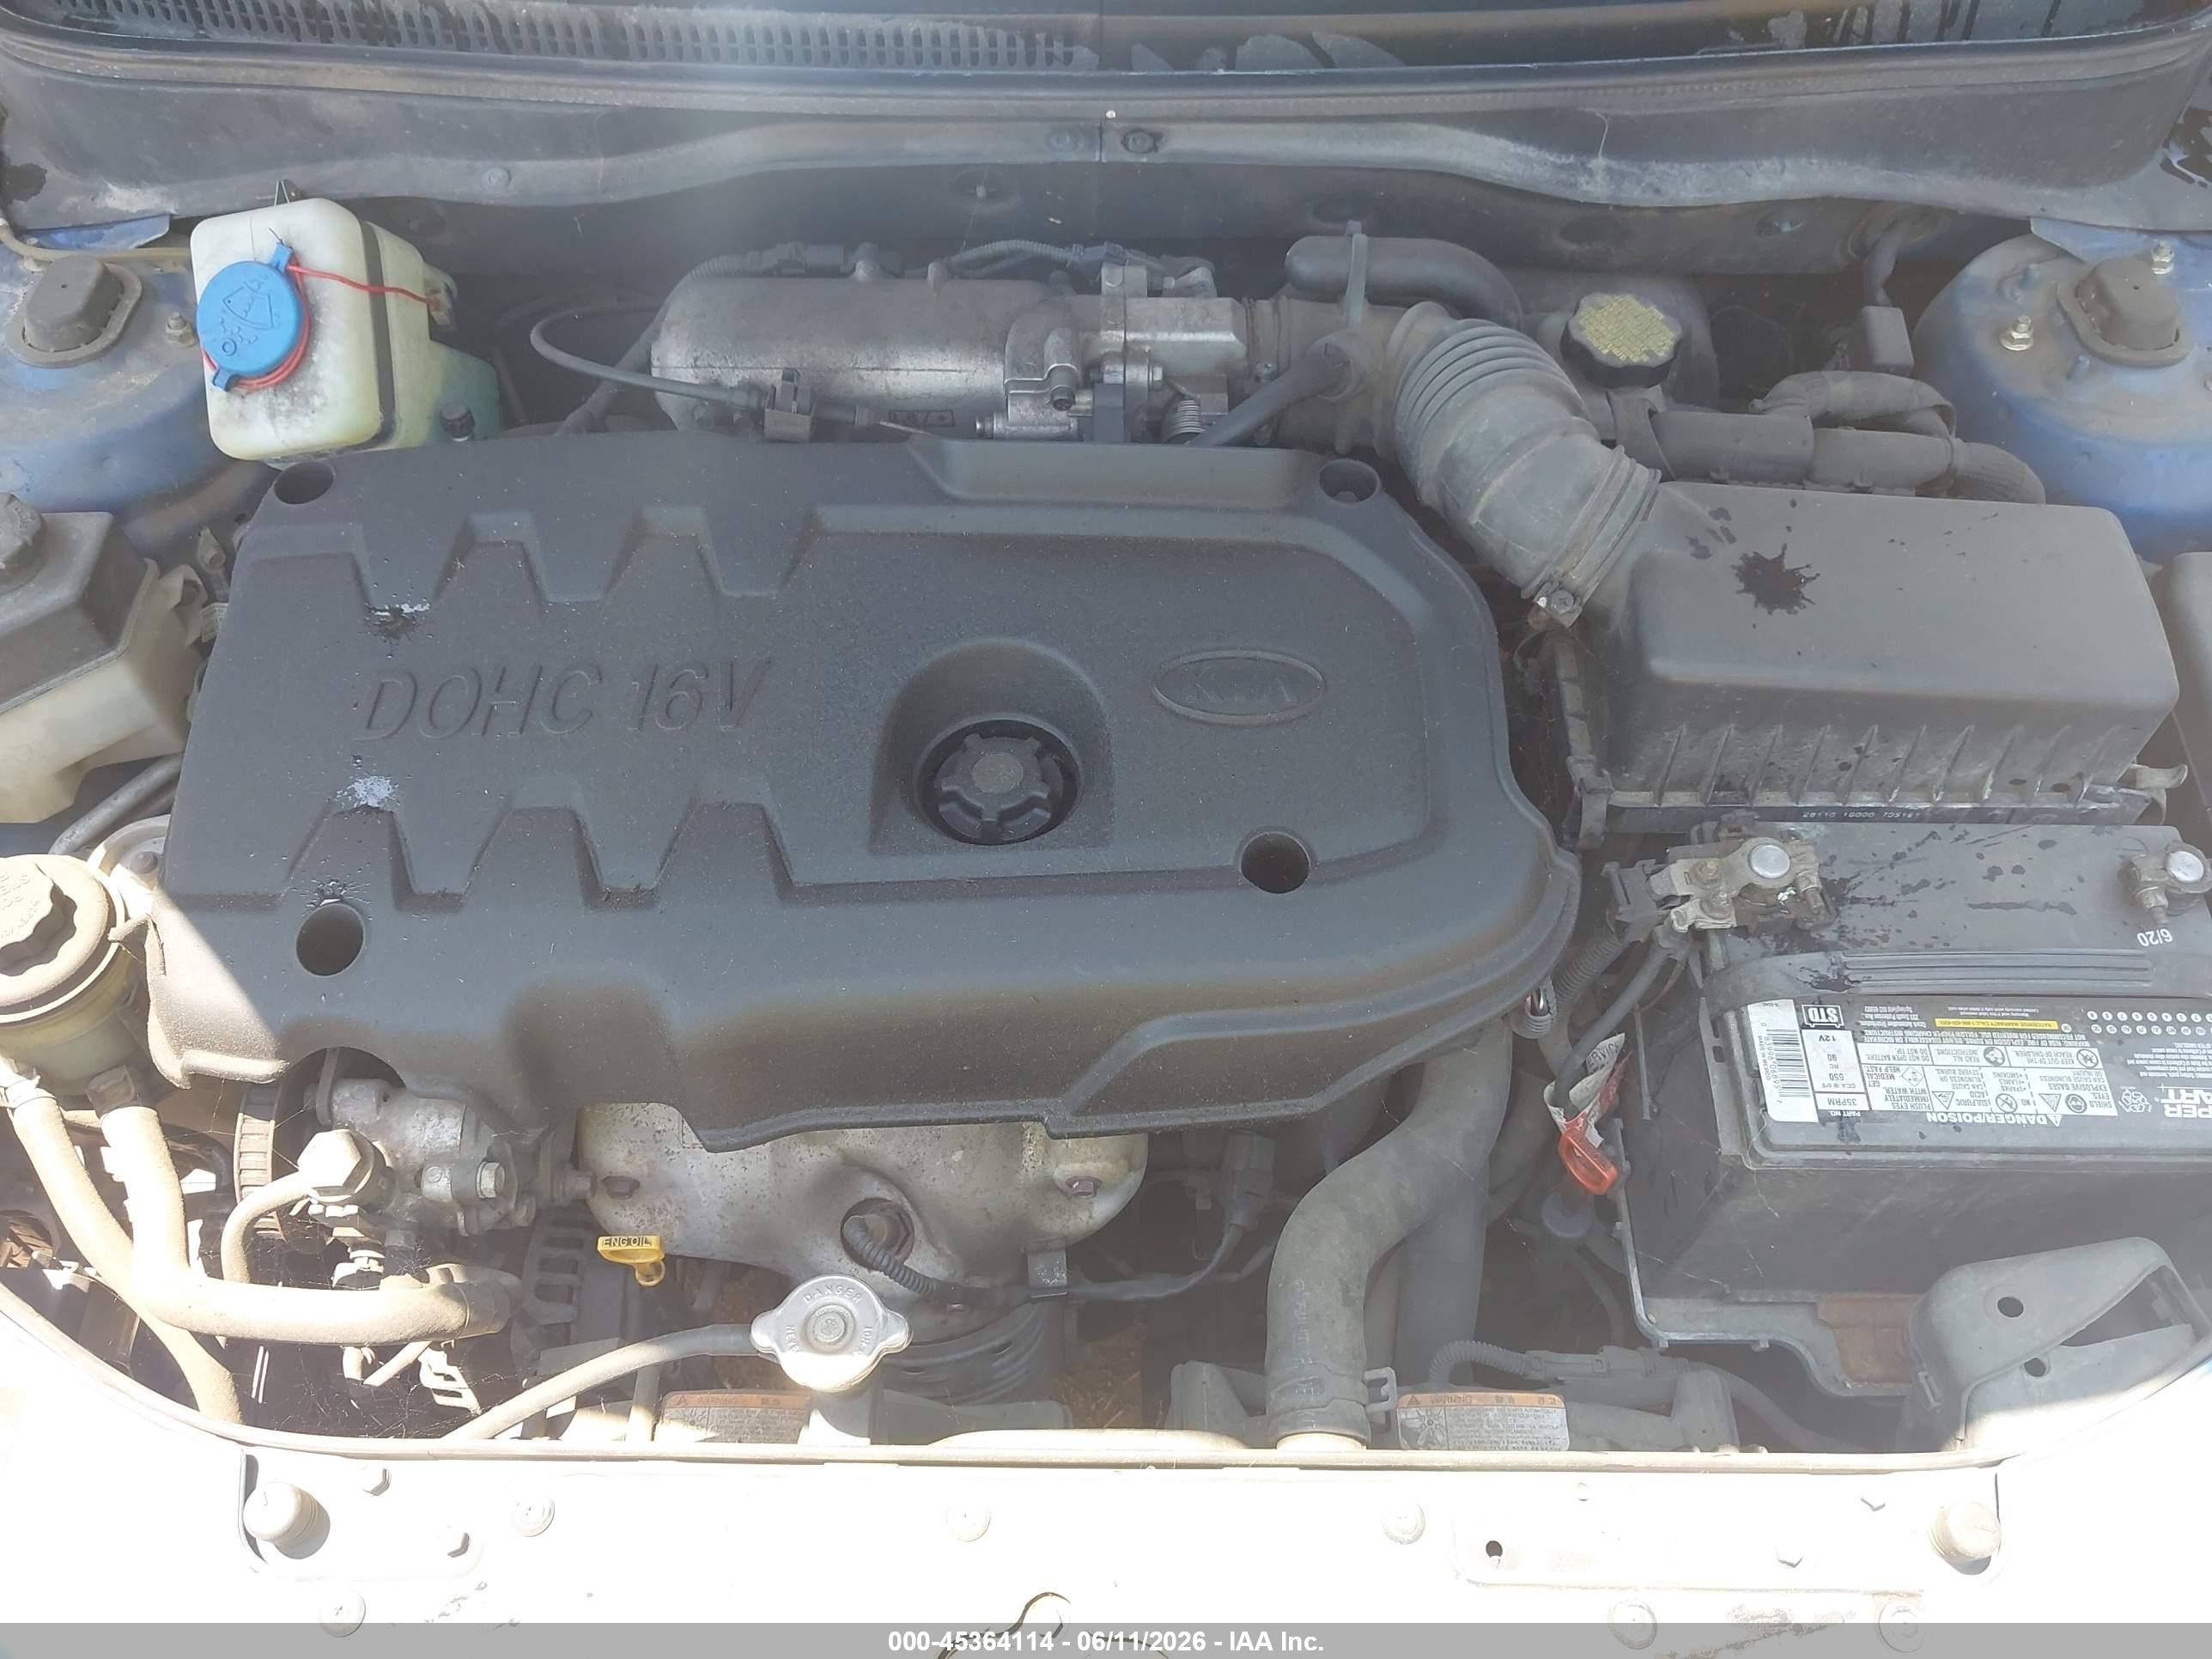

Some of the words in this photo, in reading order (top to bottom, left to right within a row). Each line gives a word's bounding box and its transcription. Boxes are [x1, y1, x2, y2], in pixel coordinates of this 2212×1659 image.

[350, 665, 604, 740] DOHC
[629, 658, 772, 731] 16V
[2136, 928, 2172, 947] 6/20
[1808, 1007, 1838, 1024] STD
[603, 1237, 628, 1248] ENG
[631, 1237, 652, 1248] OIL
[803, 1284, 864, 1304] DANGER
